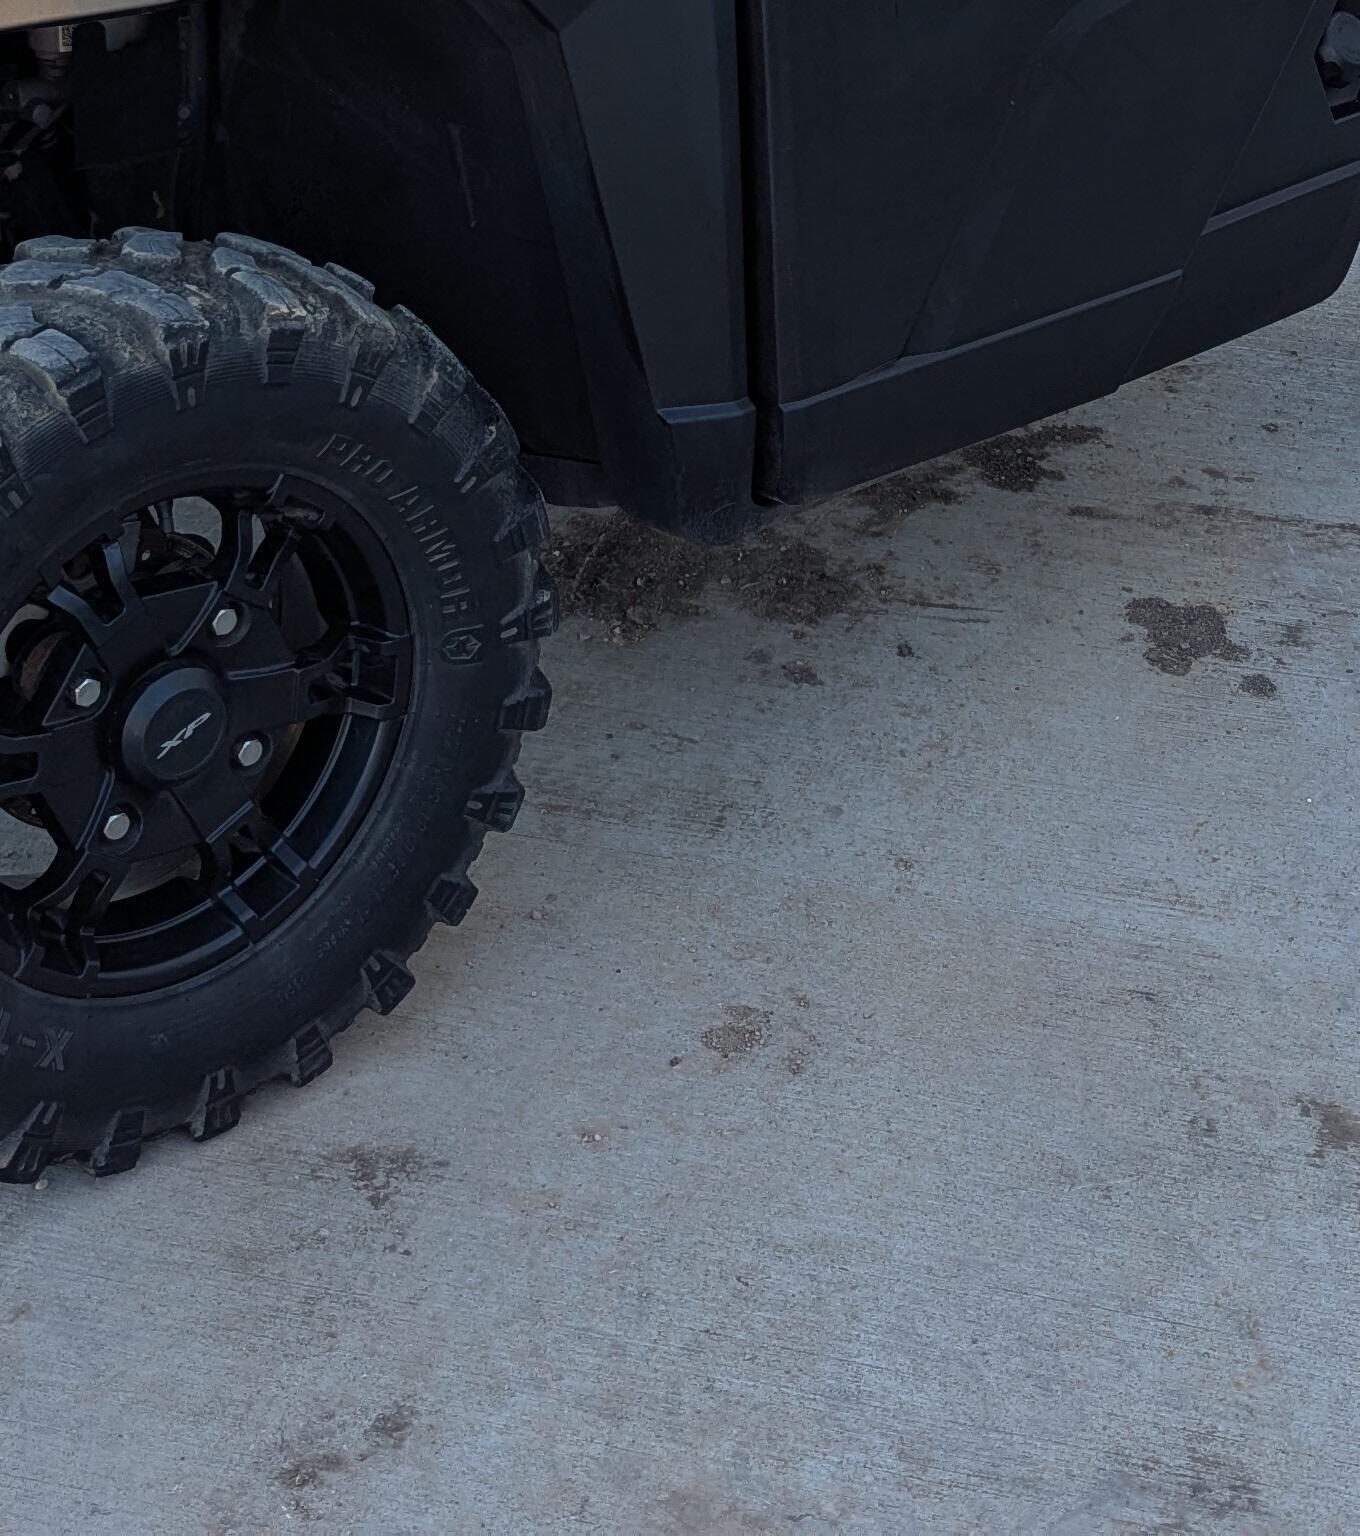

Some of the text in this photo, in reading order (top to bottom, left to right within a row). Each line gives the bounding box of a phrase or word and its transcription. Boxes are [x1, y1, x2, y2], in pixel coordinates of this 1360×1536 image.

[314, 432, 398, 487] PRO
[385, 483, 474, 616] ARMOR
[155, 711, 213, 761] XP
